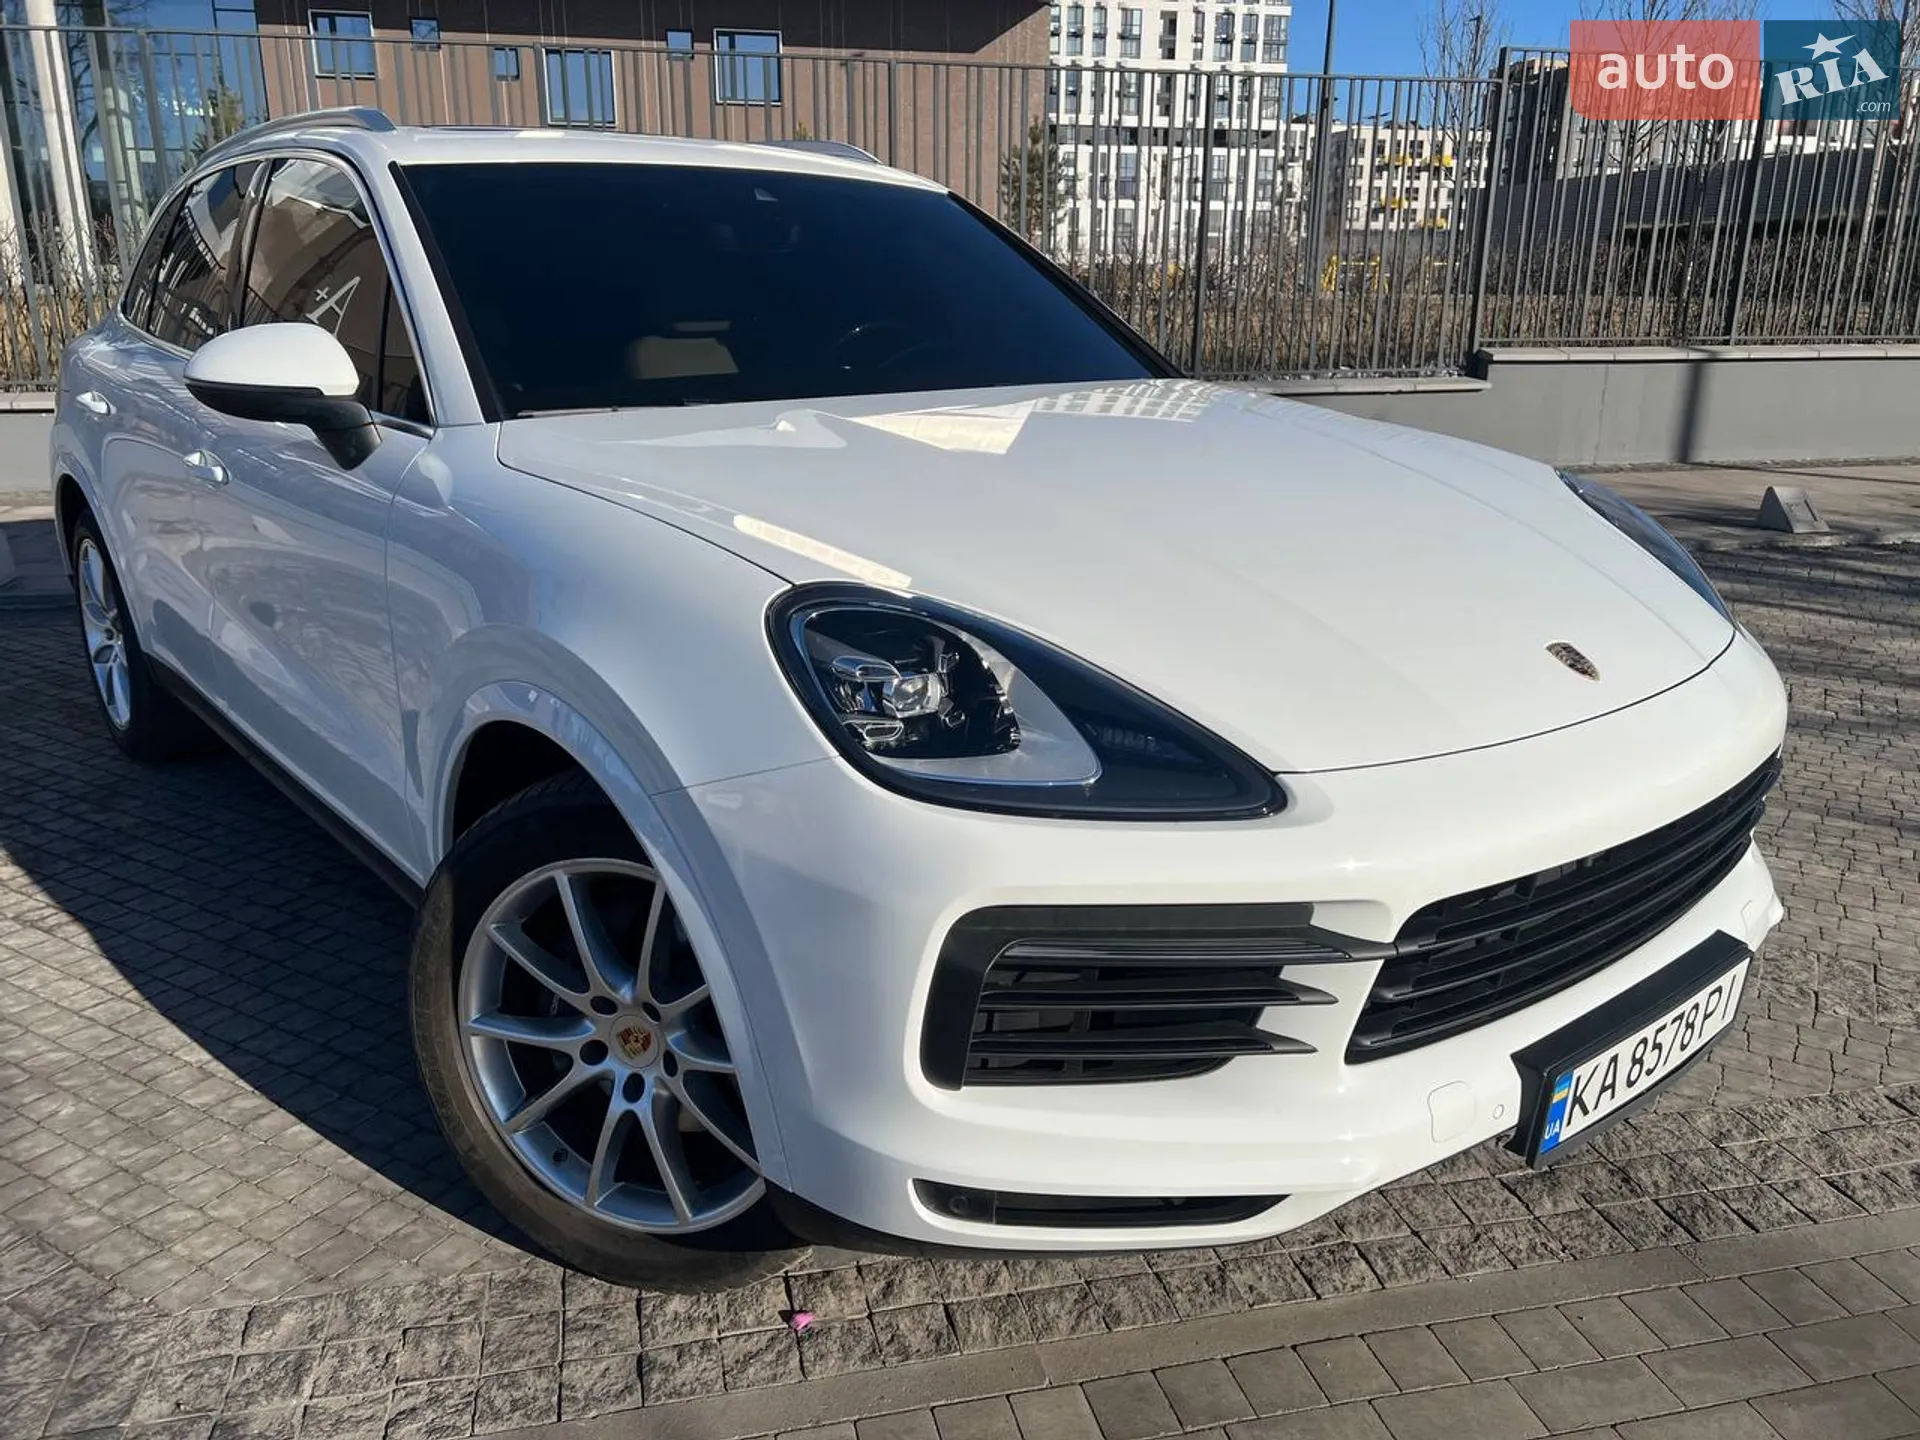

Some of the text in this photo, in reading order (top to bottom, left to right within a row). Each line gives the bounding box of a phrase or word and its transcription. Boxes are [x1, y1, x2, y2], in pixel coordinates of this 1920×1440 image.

[1566, 974, 1737, 1127] KA 8578 PI
[1544, 1124, 1560, 1139] UA
